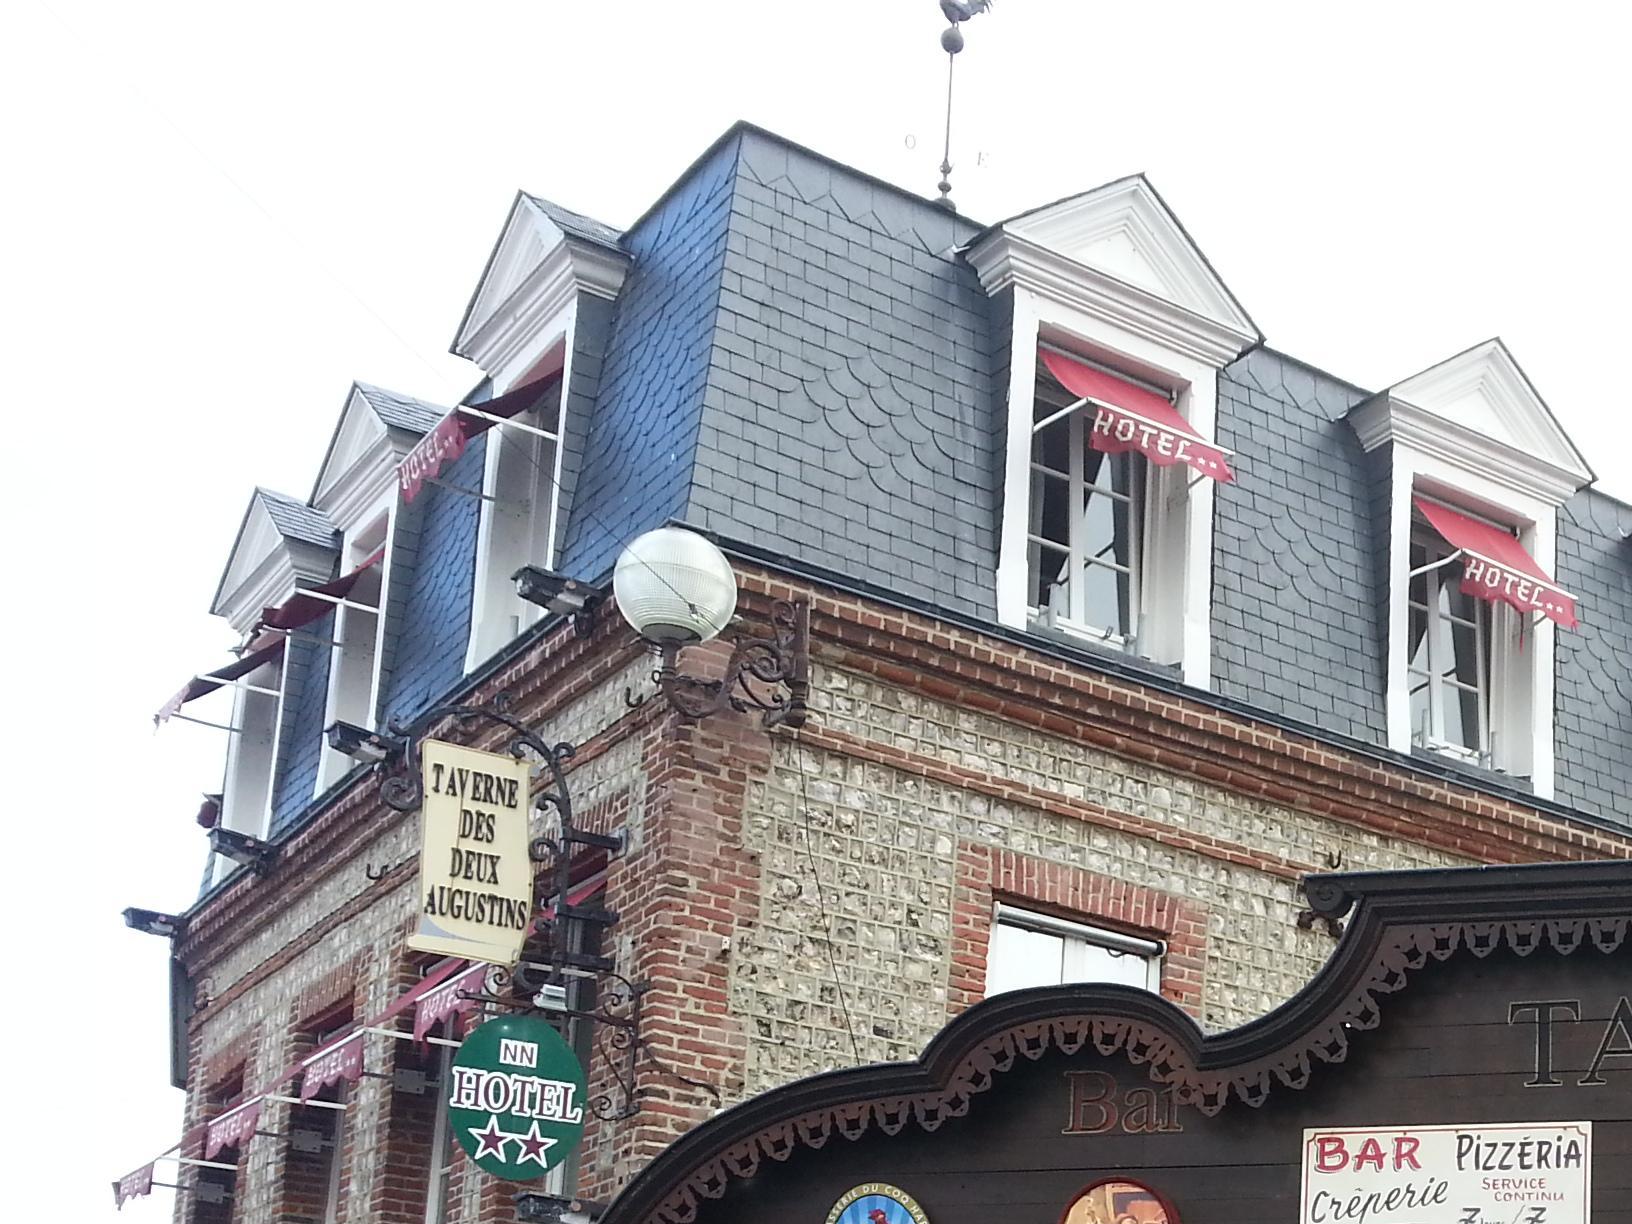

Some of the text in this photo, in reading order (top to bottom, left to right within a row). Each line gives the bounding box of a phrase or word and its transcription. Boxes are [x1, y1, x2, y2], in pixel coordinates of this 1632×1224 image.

[1093, 407, 1191, 461] HOTEL
[399, 434, 445, 491] HOTEL
[1465, 559, 1546, 608] HOTEL
[432, 762, 519, 810] TAVERNE
[460, 808, 496, 845] DES
[449, 847, 501, 885] DEUX
[424, 884, 527, 931] AUGUSTINS
[502, 1043, 536, 1065] NN
[450, 1066, 583, 1123] HOTEL
[1061, 1069, 1184, 1136] Bar
[1314, 1136, 1423, 1173] BAR
[862, 1184, 879, 1193] DU
[884, 1185, 910, 1205] COQ
[1310, 1176, 1449, 1224] Crêperie
[1482, 1177, 1547, 1190] SERVICE
[1494, 1190, 1565, 1203] CONTINU
